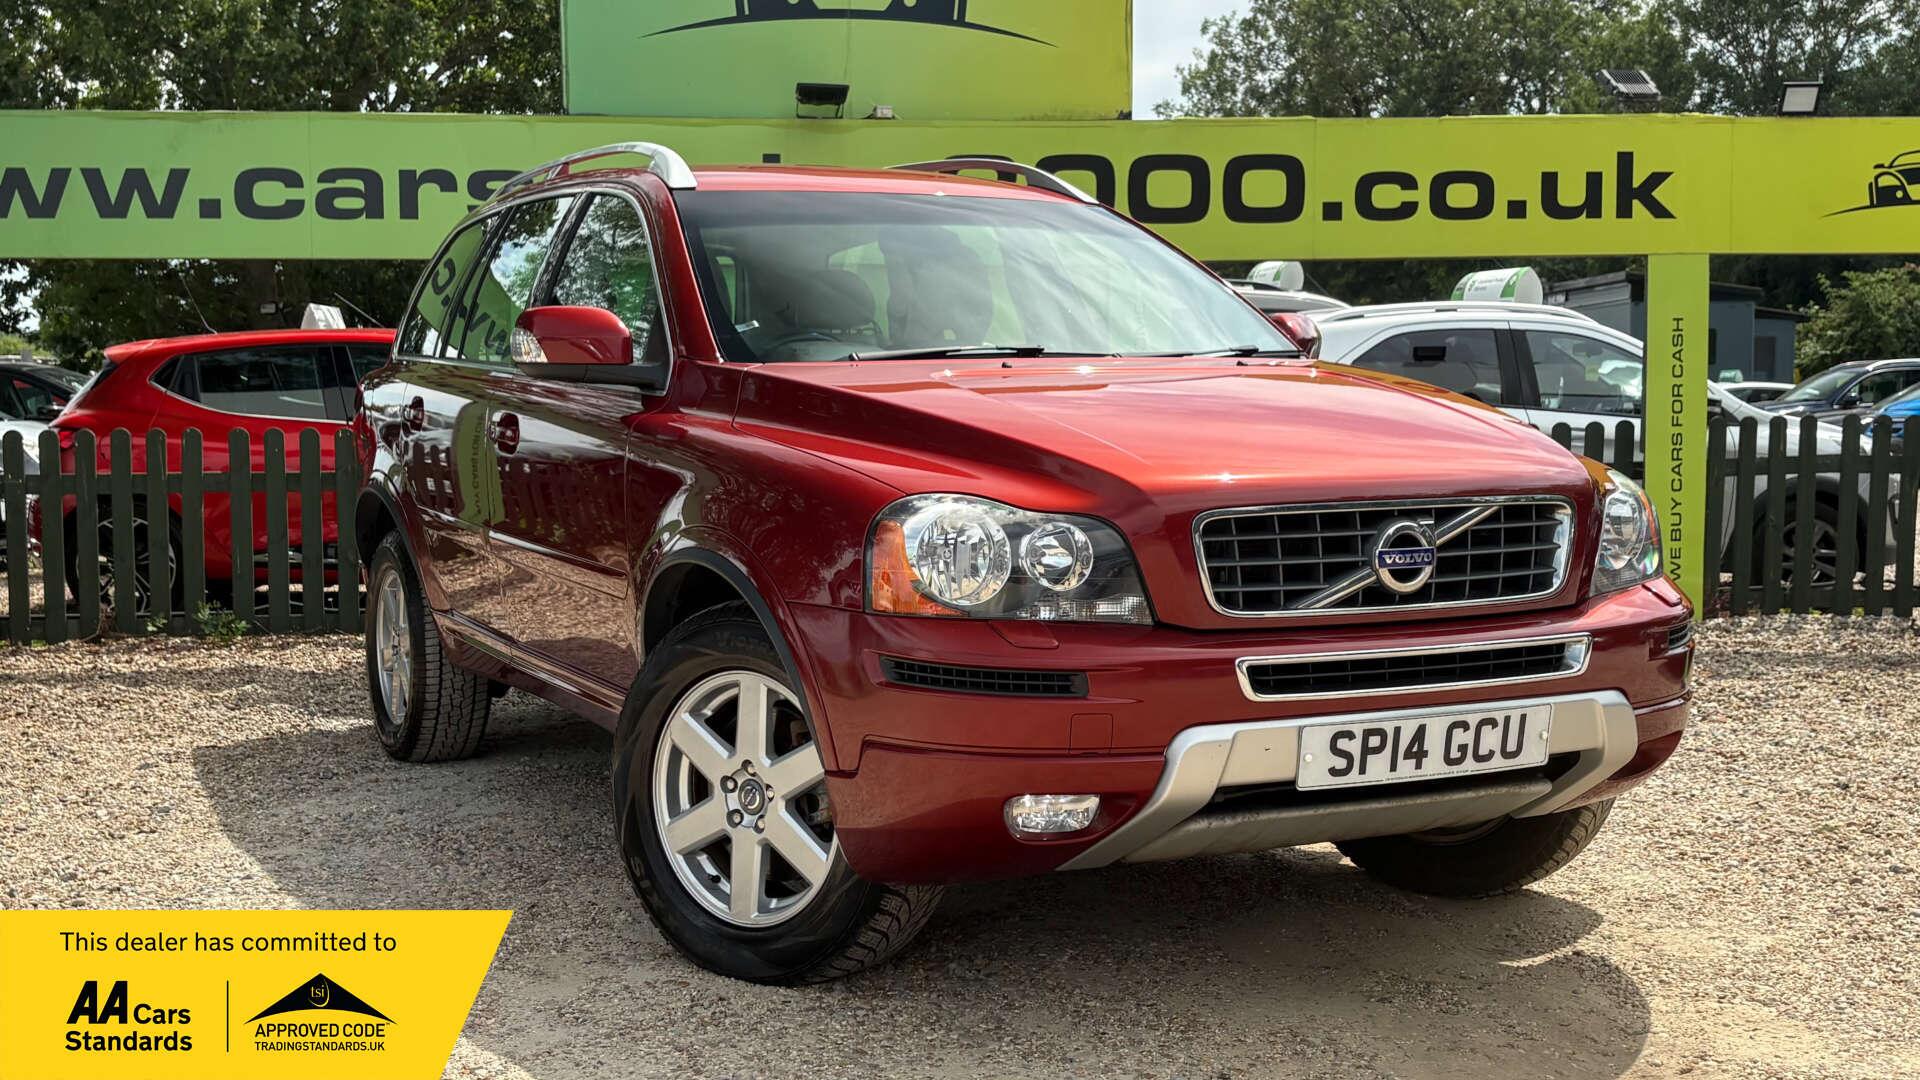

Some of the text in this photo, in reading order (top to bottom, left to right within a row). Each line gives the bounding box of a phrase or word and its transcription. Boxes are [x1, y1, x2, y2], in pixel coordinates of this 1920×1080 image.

[1670, 317, 1684, 582] WE BUY CARS FOR CASH
[1382, 552, 1432, 564] VOLVO
[1327, 713, 1528, 778] SP14 GCU
